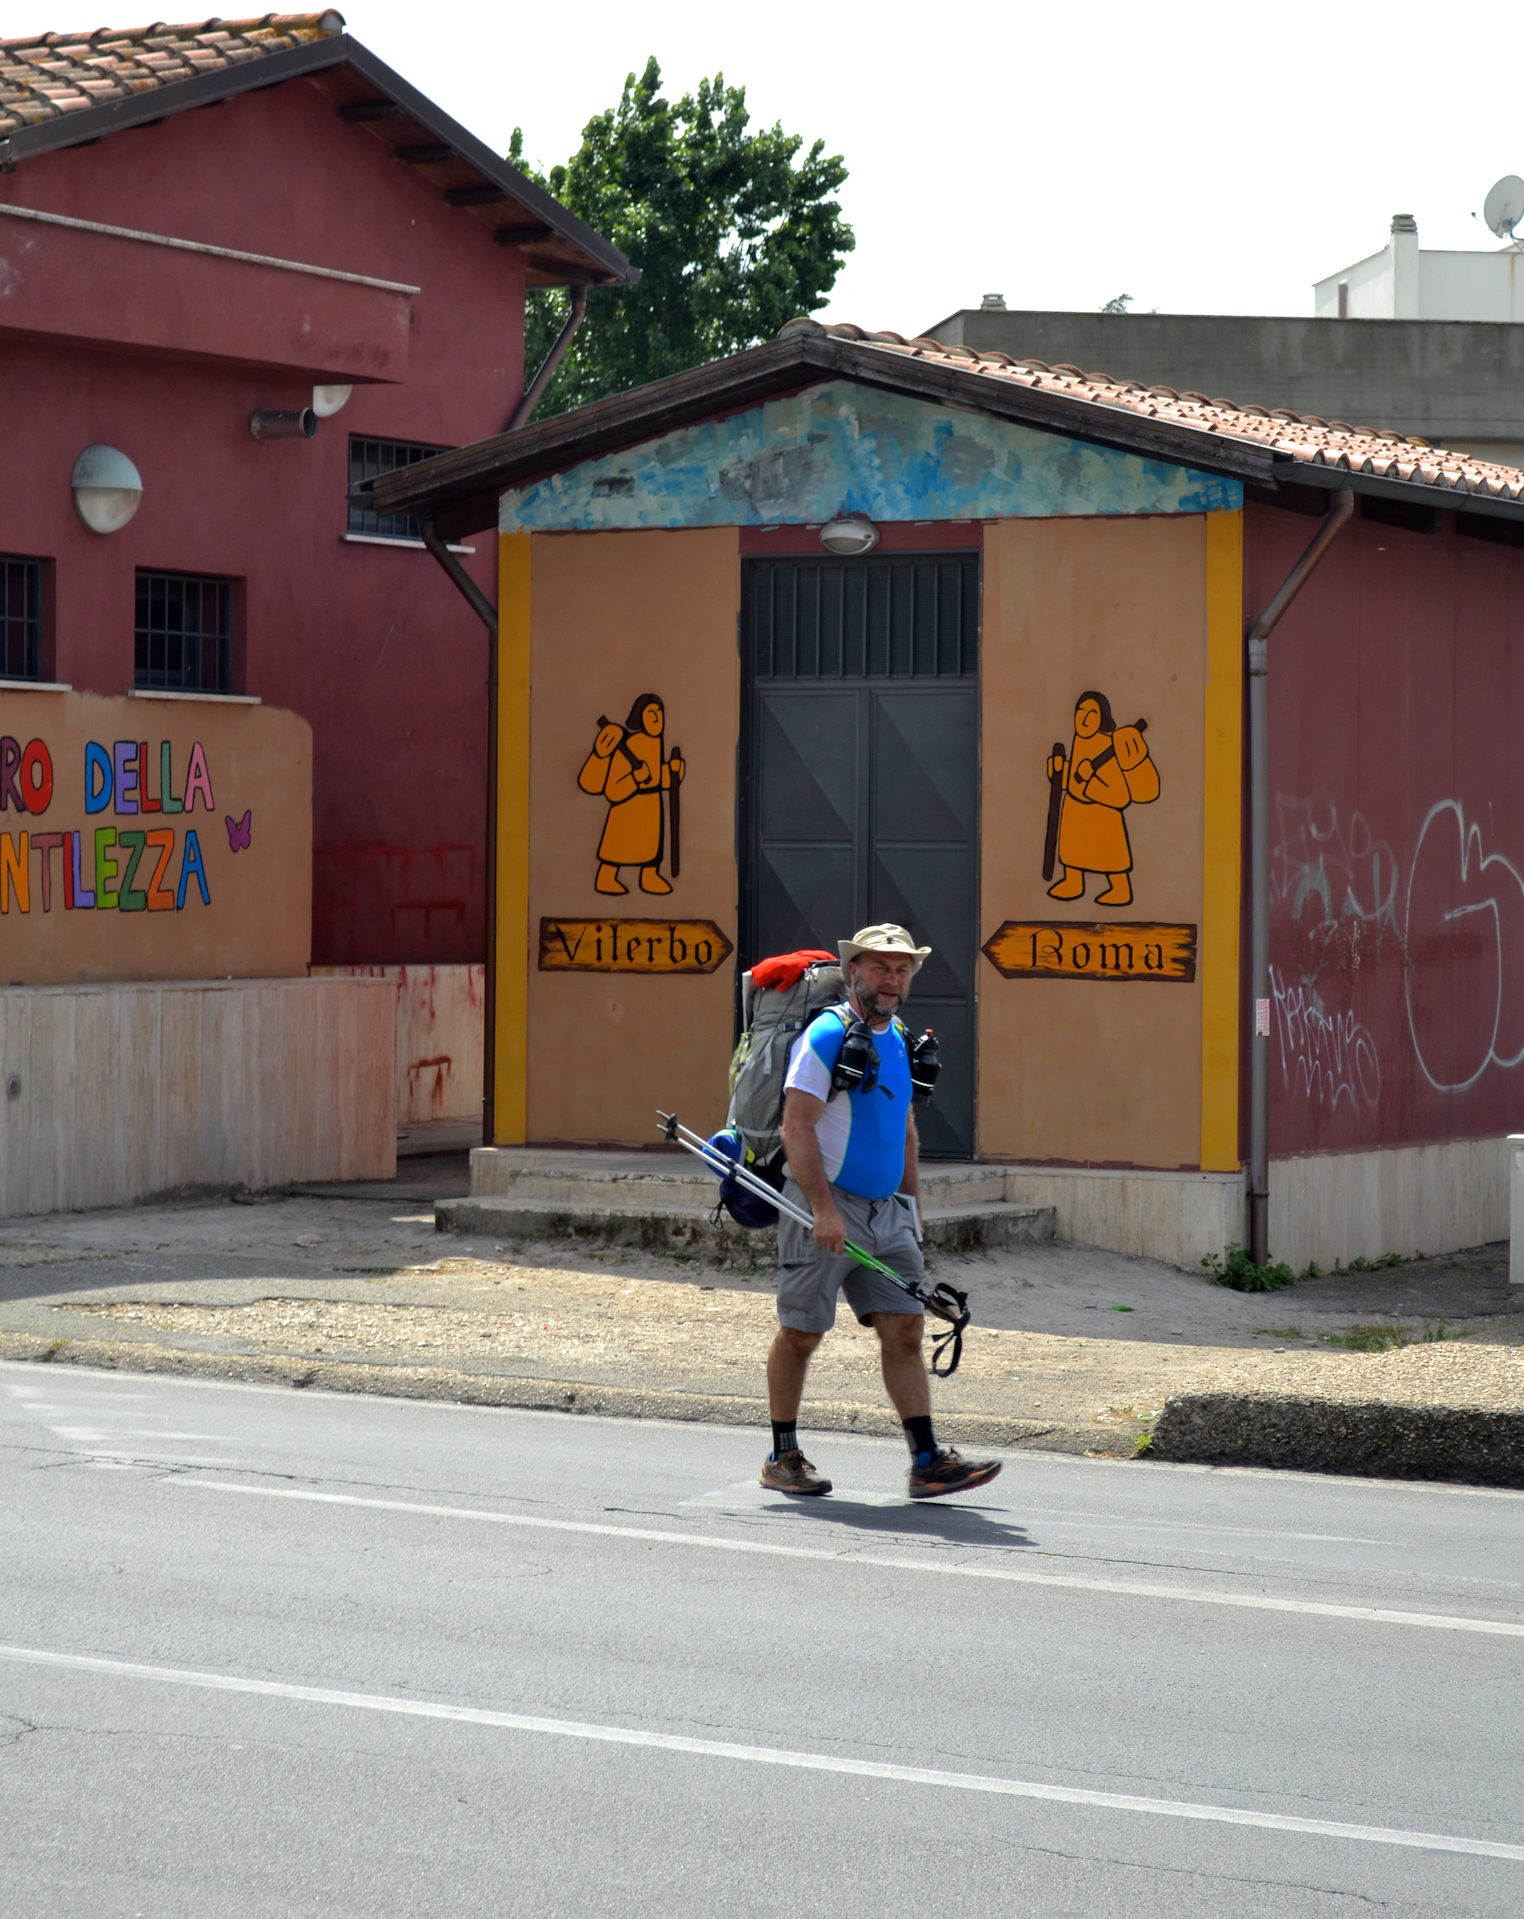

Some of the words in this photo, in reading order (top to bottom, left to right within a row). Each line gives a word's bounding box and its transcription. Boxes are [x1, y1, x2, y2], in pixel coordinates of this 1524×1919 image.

[0, 736, 53, 816] RO
[85, 740, 215, 815] DELLA
[0, 826, 211, 914] NTILEZZA
[554, 924, 712, 966] Viterbo
[1029, 928, 1165, 971] Roma
